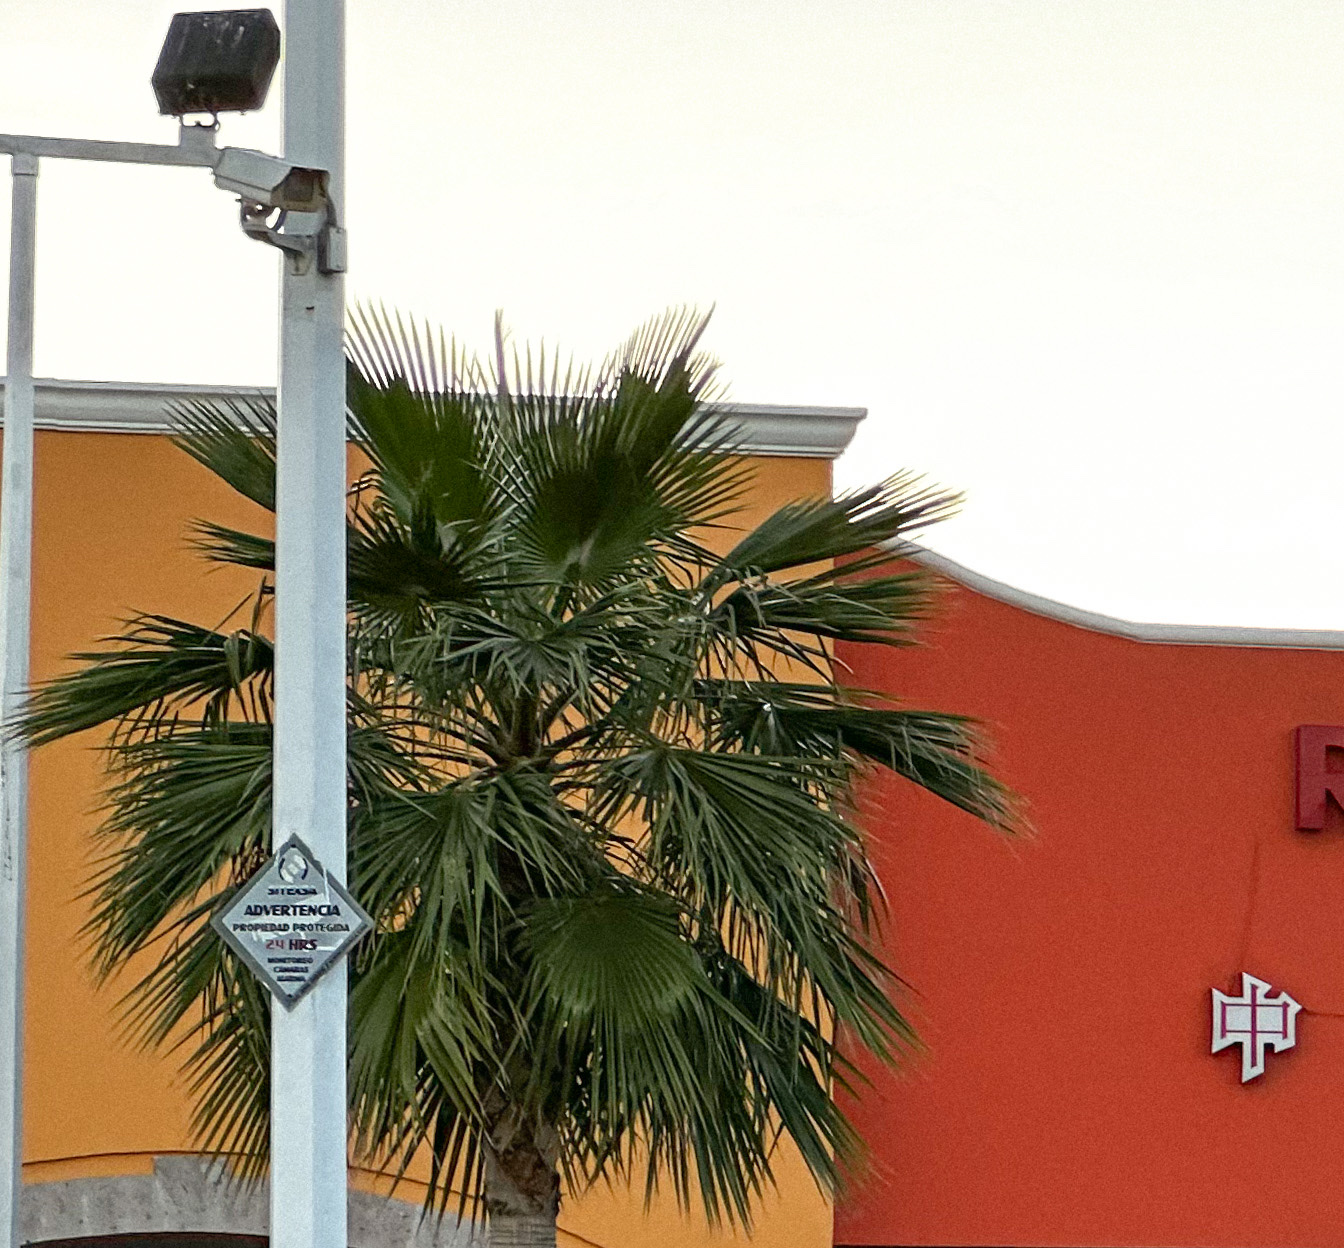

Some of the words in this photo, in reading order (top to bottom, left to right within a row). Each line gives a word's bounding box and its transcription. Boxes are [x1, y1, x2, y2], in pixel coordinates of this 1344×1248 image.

[244, 904, 341, 917] ADVERTENCIA
[232, 923, 290, 933] PROPIEDAD
[292, 922, 351, 933] PROTEGIDA
[265, 939, 285, 950] 24
[288, 938, 318, 951] HRS
